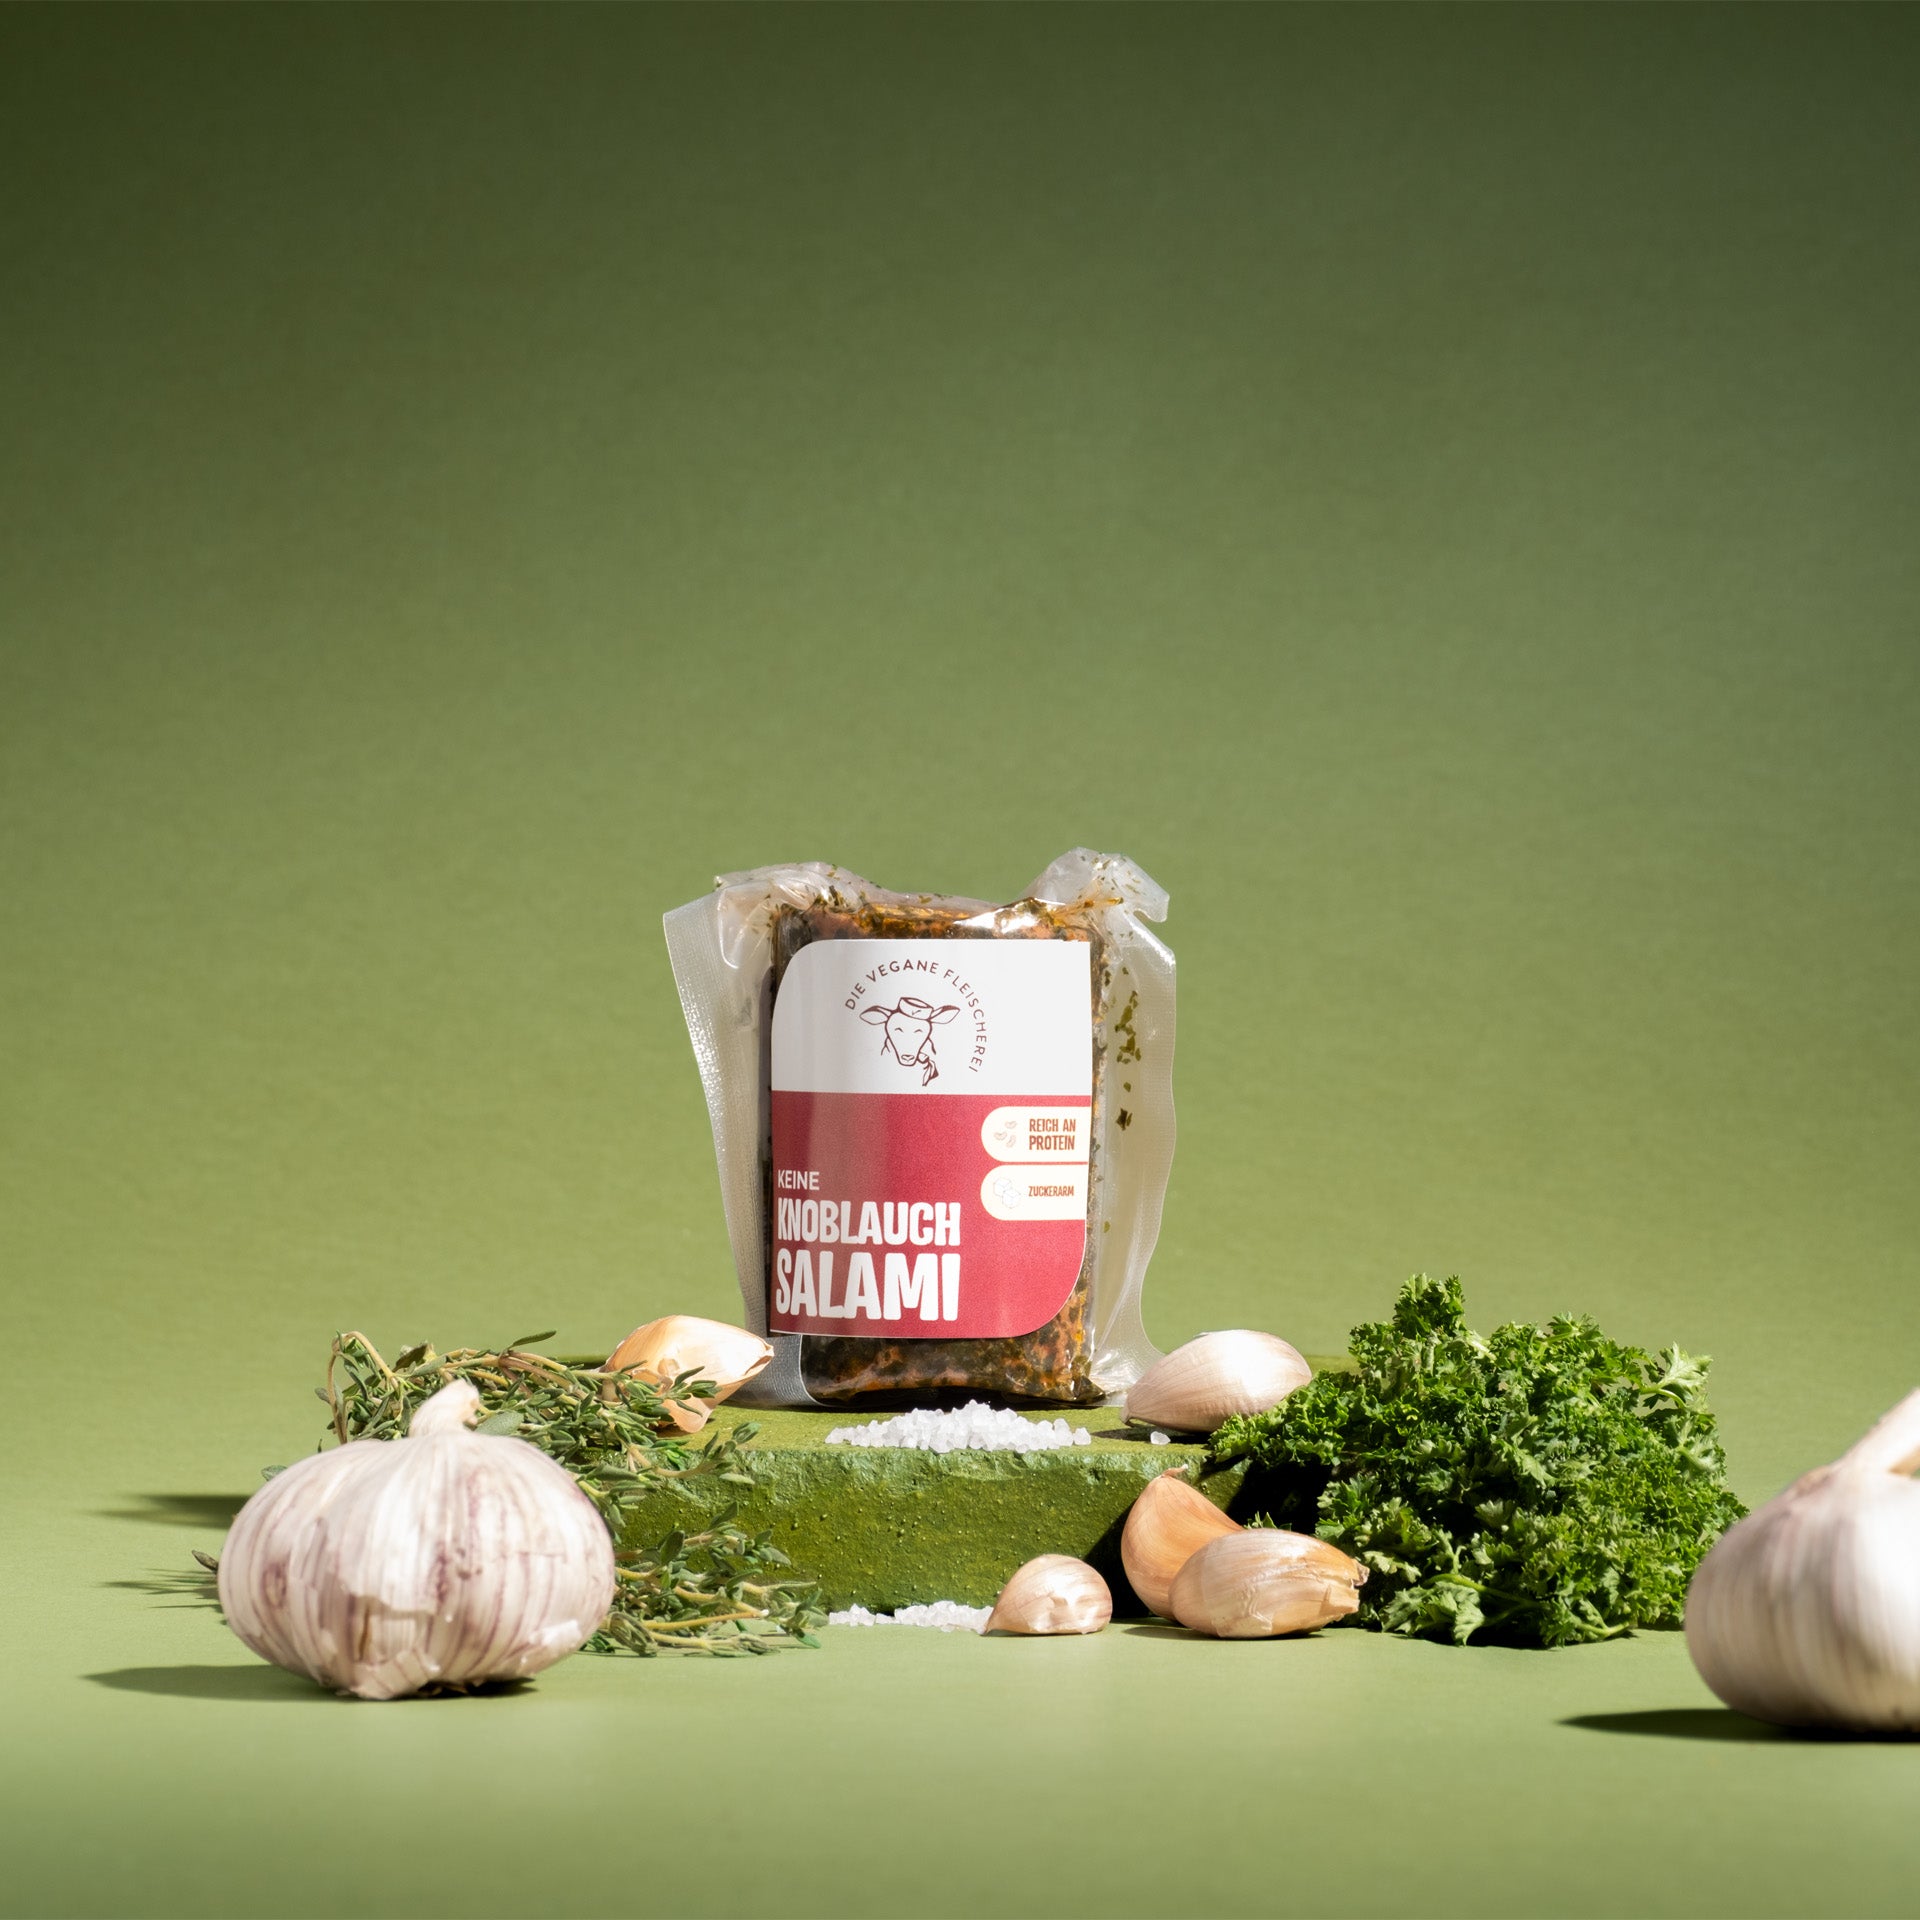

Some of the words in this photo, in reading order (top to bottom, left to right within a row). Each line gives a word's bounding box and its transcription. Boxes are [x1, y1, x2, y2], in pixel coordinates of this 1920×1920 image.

[845, 982, 866, 1010] DIE
[866, 959, 940, 983] VEGANE
[943, 969, 987, 1073] FLEISCHEREI
[1029, 1118, 1059, 1133] REICH
[1062, 1118, 1077, 1133] AN
[1028, 1135, 1076, 1151] PROTEIN
[777, 1169, 820, 1191] KEINE
[1028, 1185, 1075, 1197] ZUCKERARM
[777, 1197, 961, 1247] KNOBLAUCH
[775, 1248, 961, 1322] SALAMI
